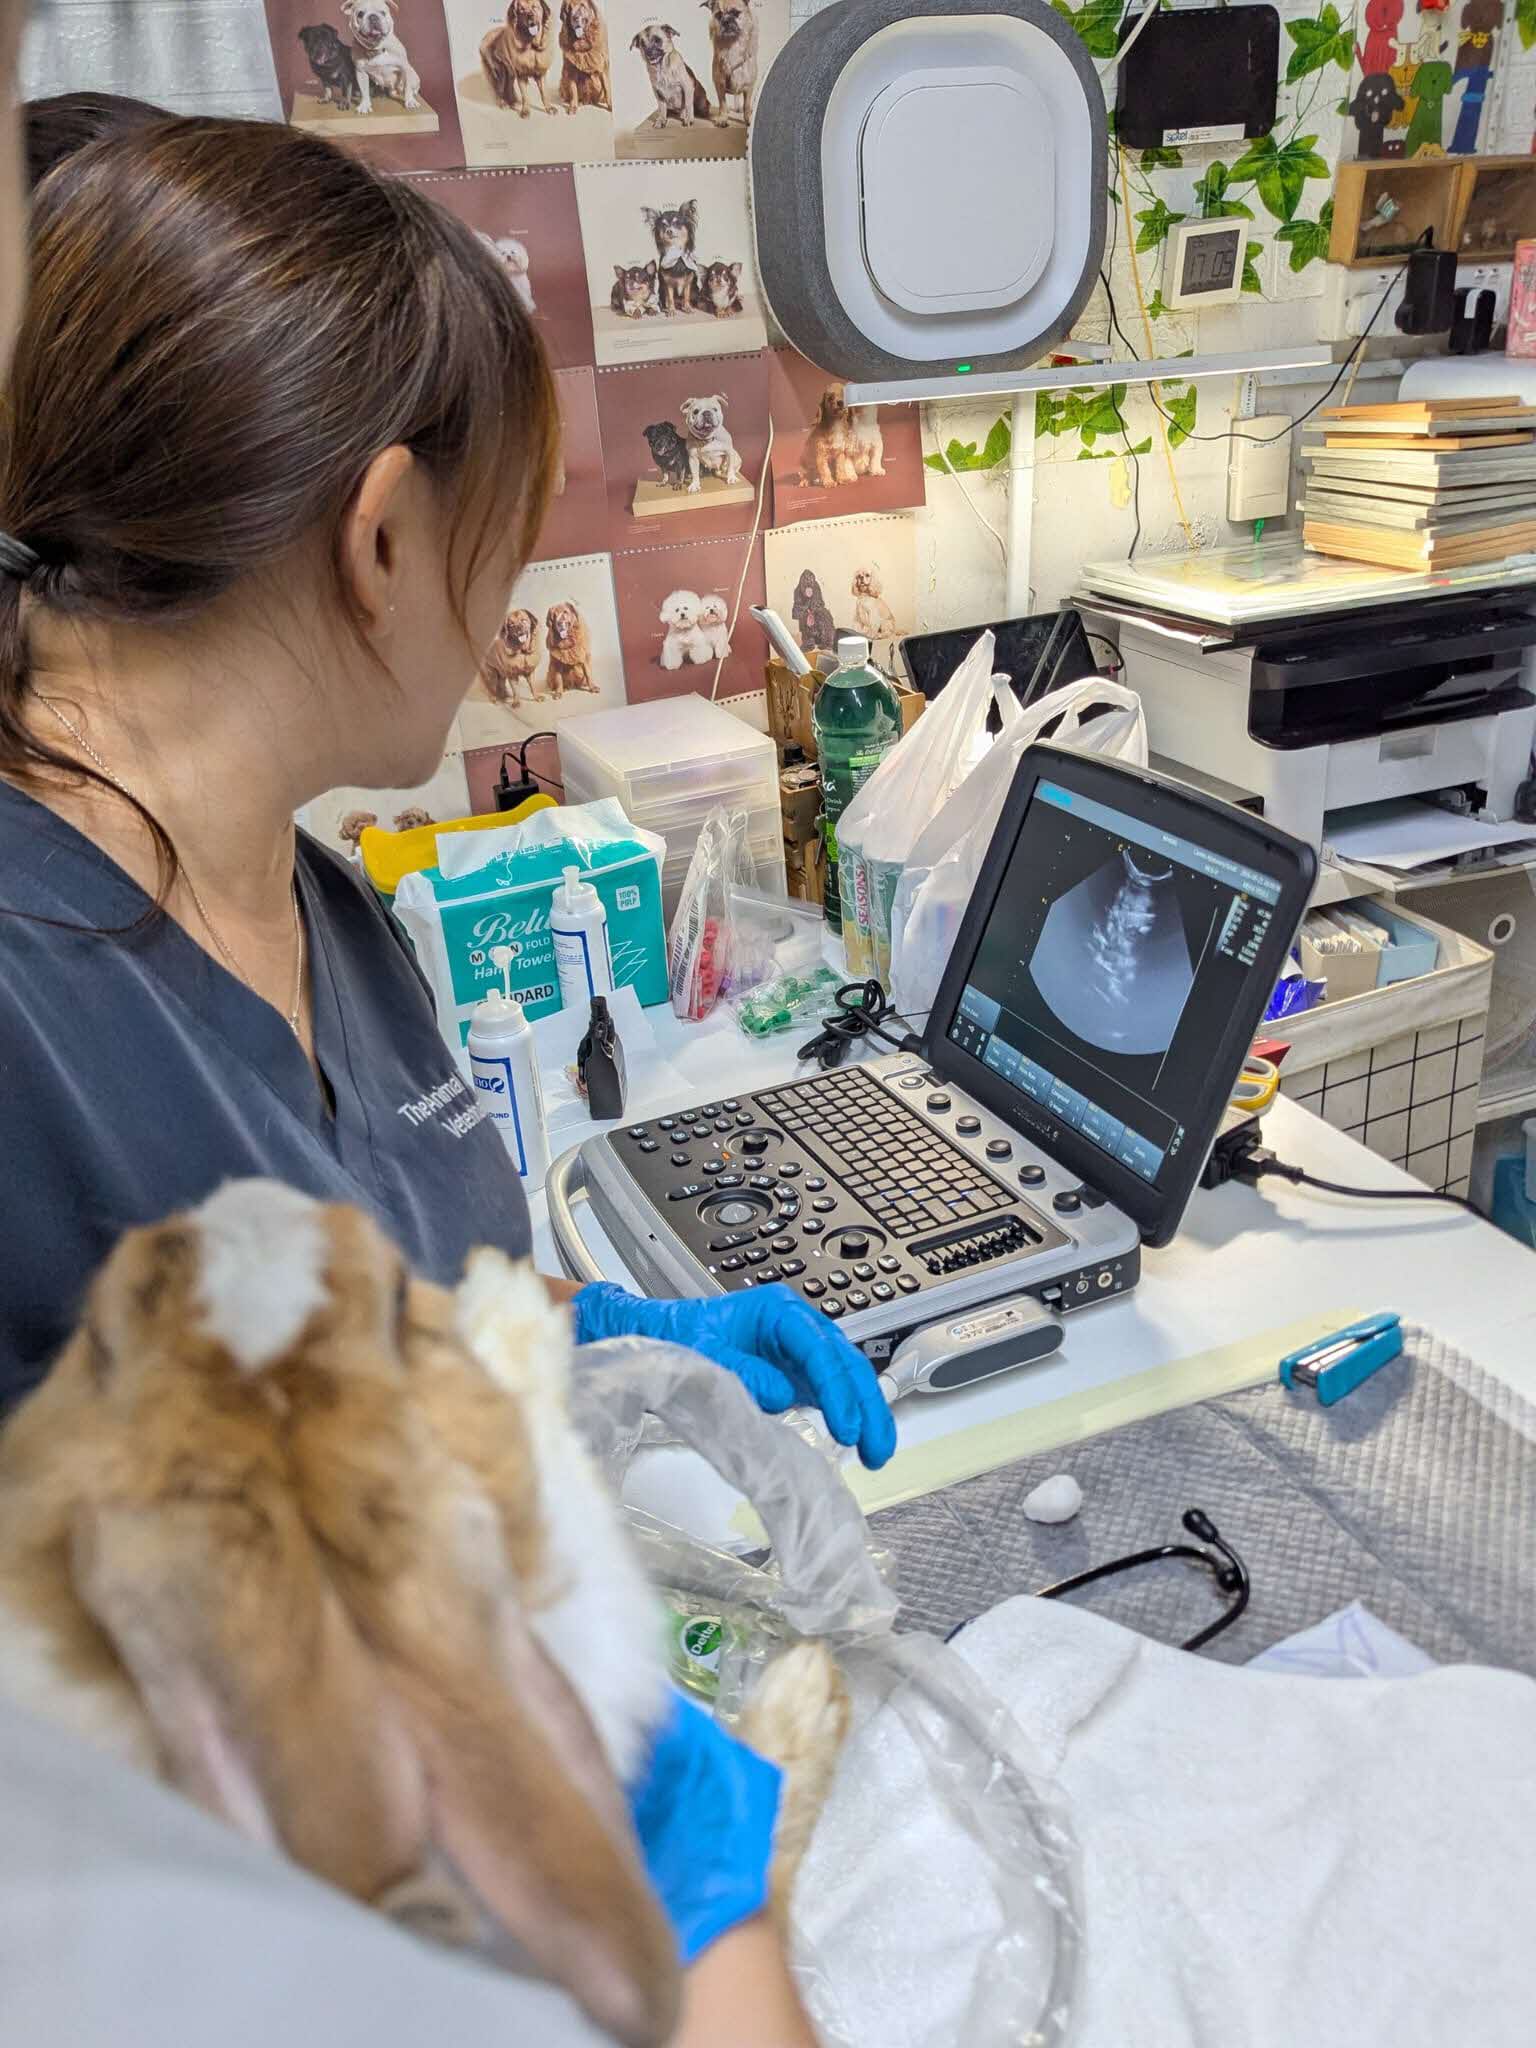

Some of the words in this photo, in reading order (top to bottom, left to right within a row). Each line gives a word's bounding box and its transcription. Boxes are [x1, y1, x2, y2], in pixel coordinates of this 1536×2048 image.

[526, 937, 550, 950] FOLD
[474, 966, 503, 981] Han
[691, 1622, 719, 1655] Dettol
